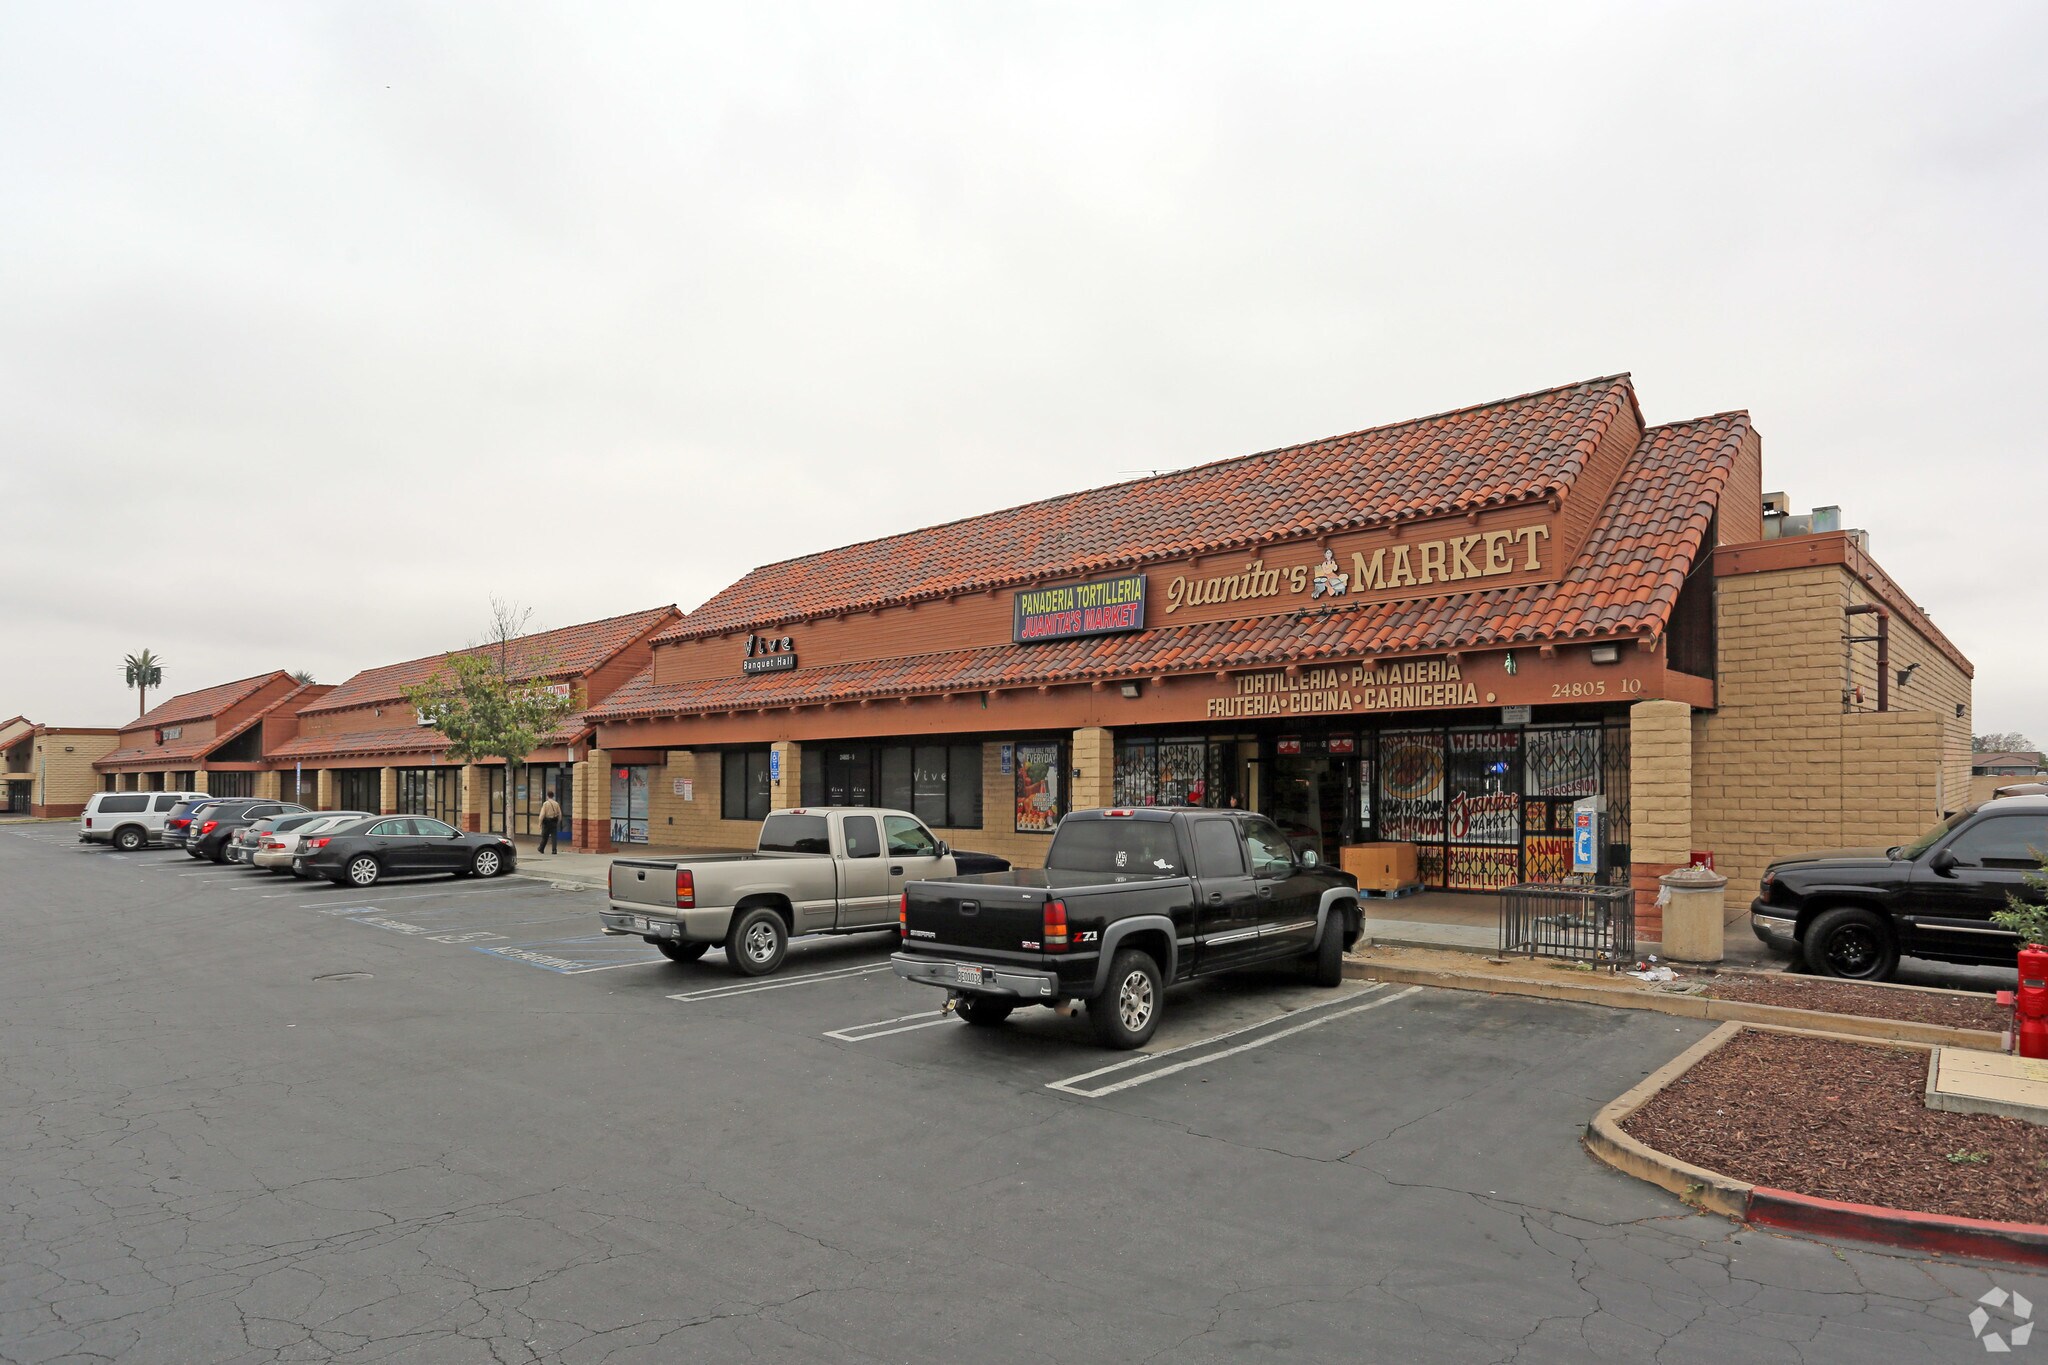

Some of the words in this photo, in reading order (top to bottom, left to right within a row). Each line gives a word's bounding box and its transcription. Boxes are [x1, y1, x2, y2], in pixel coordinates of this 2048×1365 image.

[1165, 560, 1308, 613] Juanita's
[1351, 524, 1549, 593] MARKET
[1022, 588, 1074, 616] PANADERIA
[1076, 578, 1141, 608] TORTILLERIA
[1021, 610, 1081, 638] JUANITA'S
[1083, 602, 1138, 631] MARKET
[744, 634, 793, 657] Vive
[743, 659, 774, 671] Banquet
[777, 656, 793, 666] Hall
[1235, 668, 1339, 695] TORTILLERIA
[1352, 661, 1461, 687] PANADERIA
[1551, 681, 1605, 698] 24805
[1621, 678, 1641, 693] 10
[1207, 695, 1281, 718] FRUTERIA
[1289, 690, 1353, 713] COCINA
[1364, 682, 1479, 709] CARNICERIA
[1451, 732, 1519, 751] WELCOME
[1026, 753, 1056, 763] EVERYDAY
[757, 771, 769, 783] Vi
[914, 768, 947, 782] Vive
[1073, 931, 1097, 942] Z71
